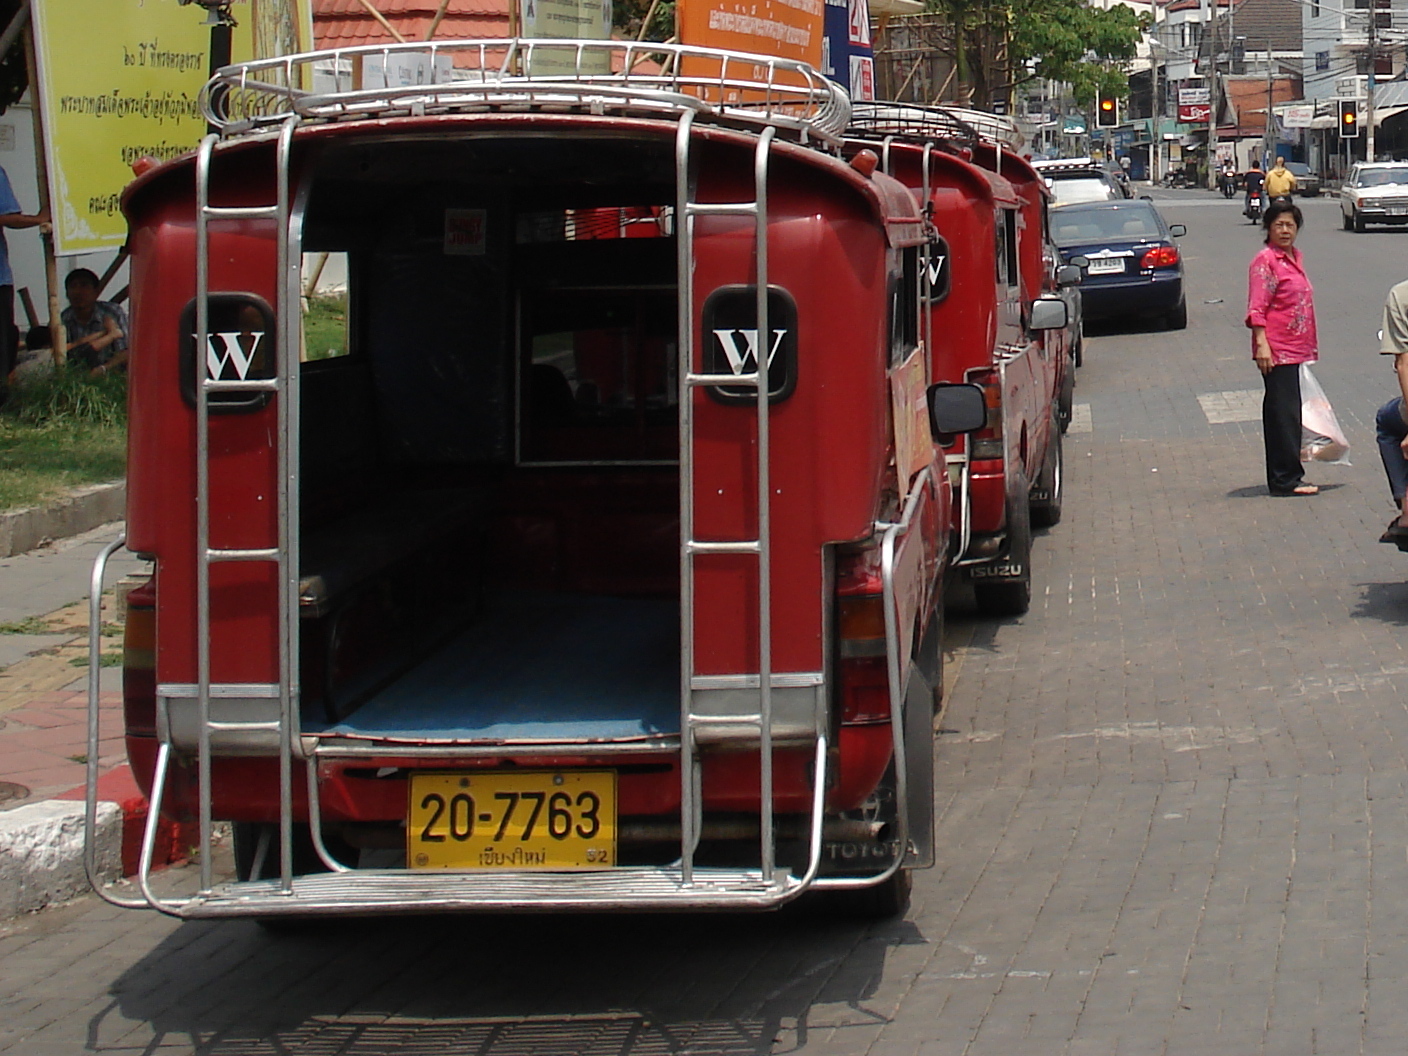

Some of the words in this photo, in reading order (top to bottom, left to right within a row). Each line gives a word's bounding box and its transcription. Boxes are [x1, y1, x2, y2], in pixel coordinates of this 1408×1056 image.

[191, 331, 265, 381] W
[712, 329, 787, 376] W
[970, 564, 1022, 578] ISUZU
[421, 790, 600, 842] 20-7763
[479, 846, 546, 865] เชียงใหม่
